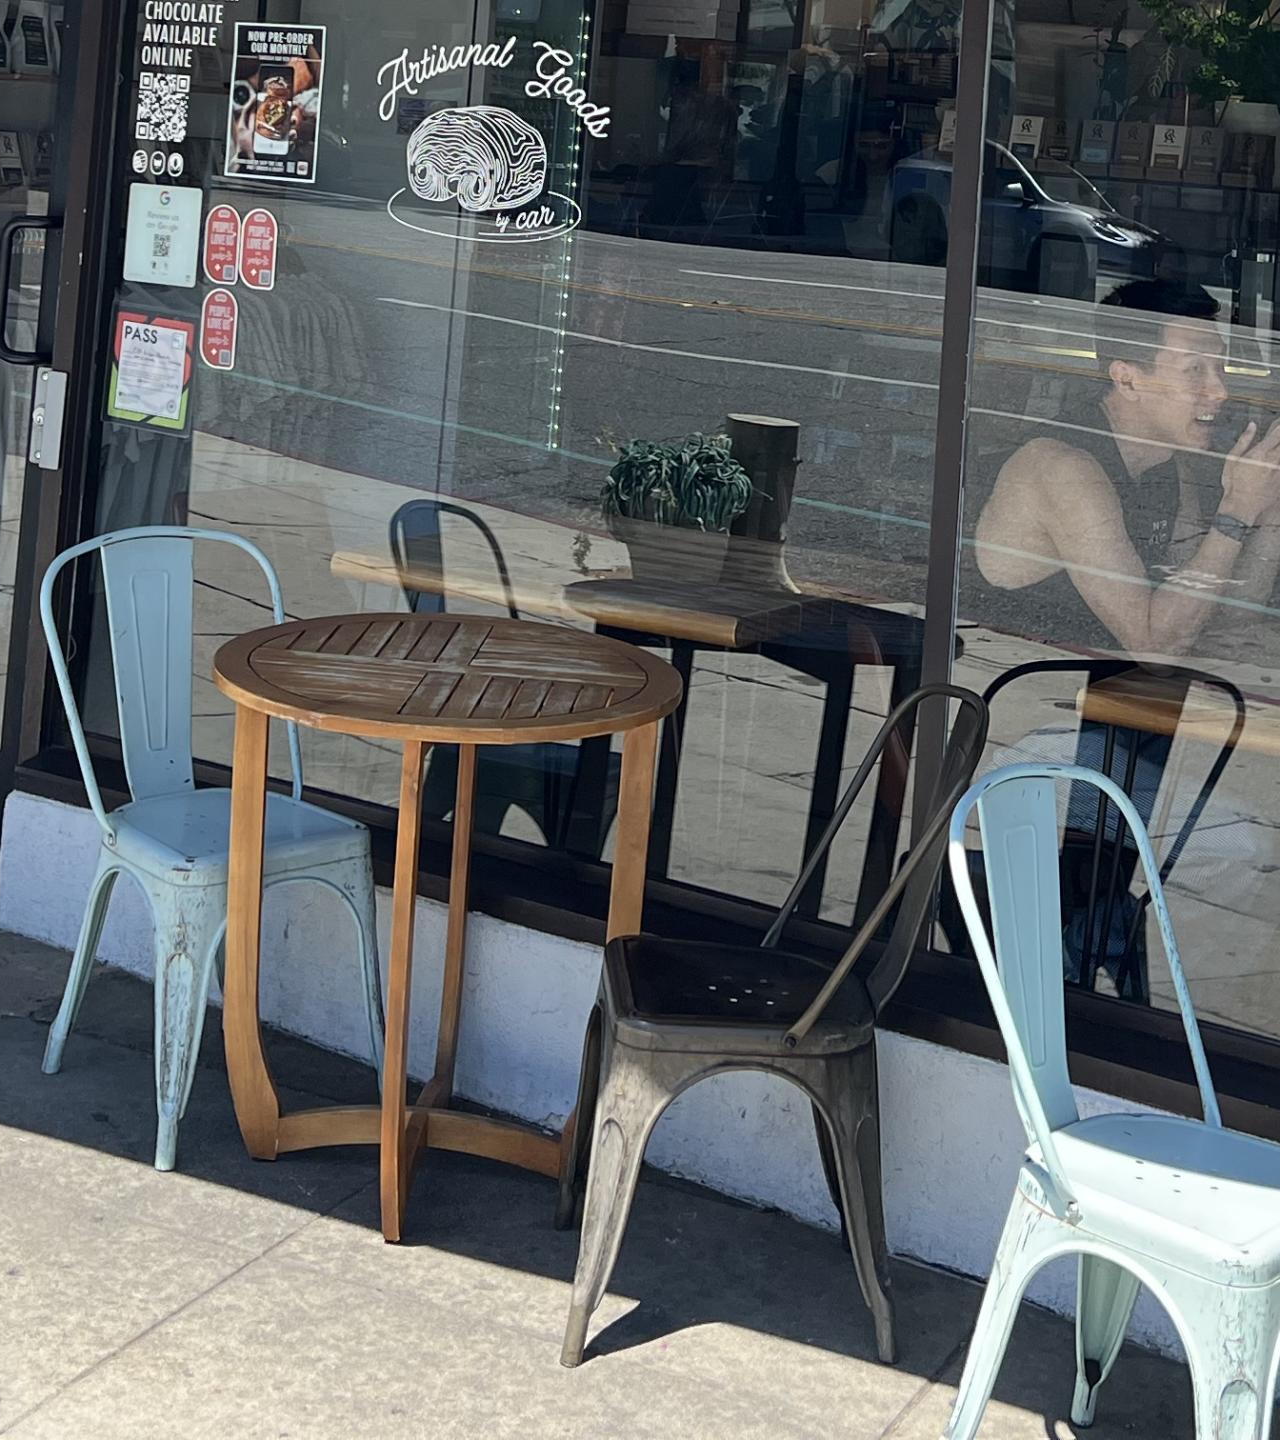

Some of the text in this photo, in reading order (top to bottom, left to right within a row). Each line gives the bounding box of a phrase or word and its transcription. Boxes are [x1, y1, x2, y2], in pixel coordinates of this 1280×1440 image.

[145, 1, 224, 24] CHOCOLATE
[142, 23, 218, 47] AVAILABLE
[247, 31, 314, 45] NOW PRE-ORDER
[250, 42, 308, 56] OUR MONTHLY
[141, 45, 193, 68] ONLINE
[377, 36, 611, 138] Artisanal Goods
[160, 191, 171, 205] G
[495, 205, 555, 233] by car
[157, 222, 178, 232] Google
[212, 221, 235, 234] PEOPLE
[248, 225, 271, 238] PEOPLE
[210, 233, 224, 246] LOVE
[246, 238, 260, 250] LOVE
[208, 305, 231, 318] PEOPLE
[207, 317, 222, 330] LOVE
[125, 325, 158, 344] PASS
